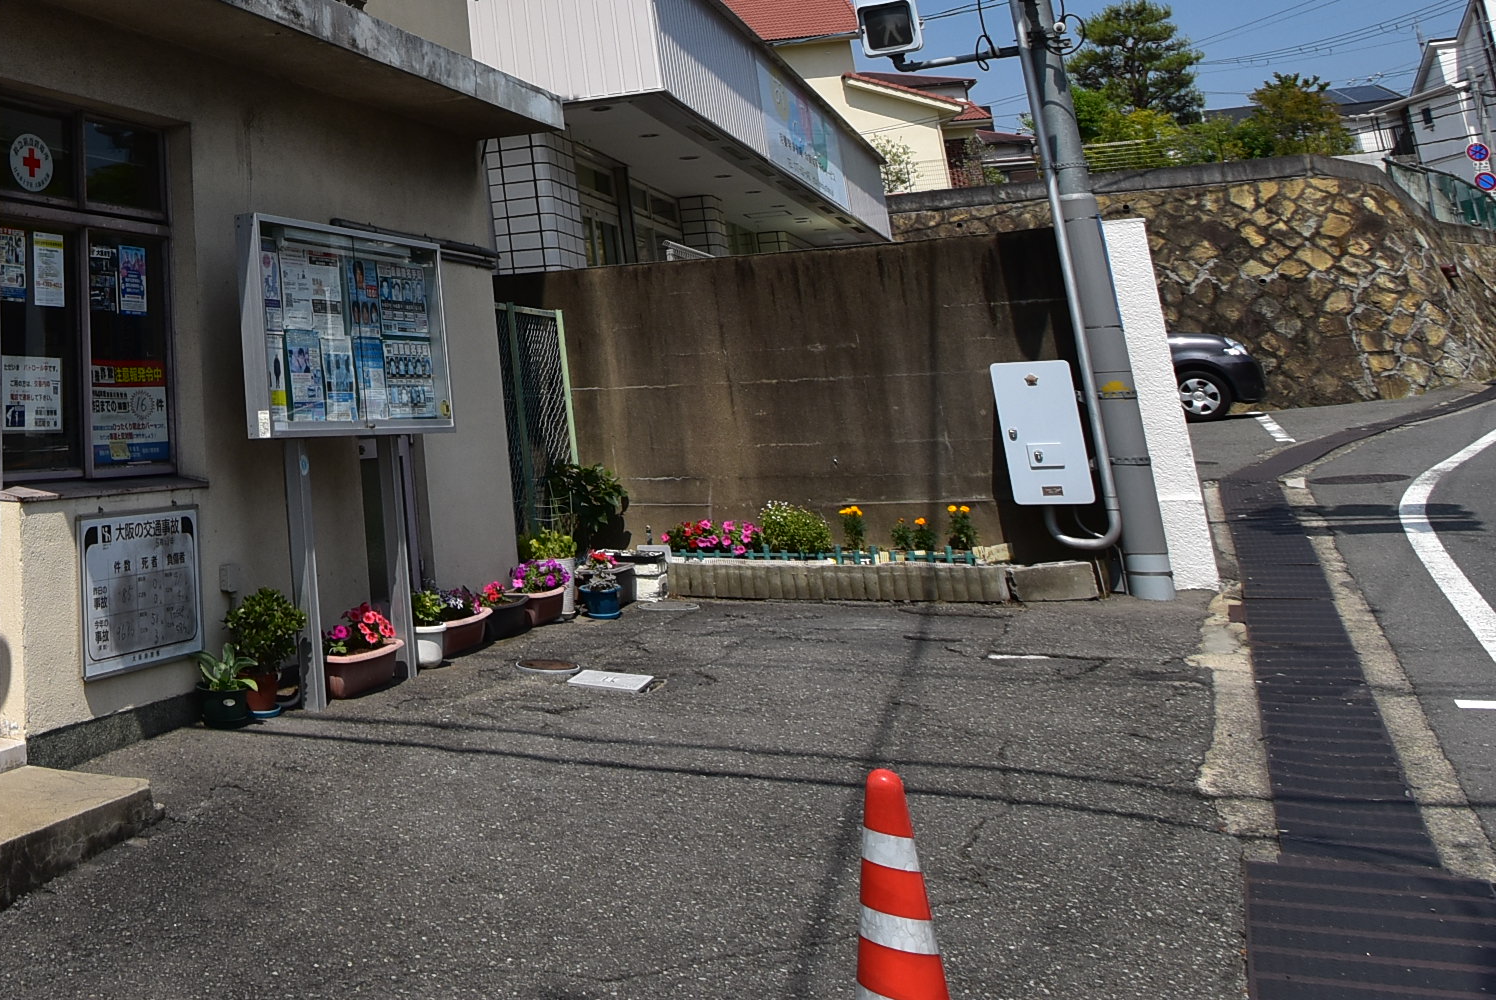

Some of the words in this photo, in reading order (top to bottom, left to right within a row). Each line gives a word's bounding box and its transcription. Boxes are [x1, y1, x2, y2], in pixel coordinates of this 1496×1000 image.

[115, 367, 162, 382] 注意報発令中
[136, 396, 147, 412] 16
[156, 399, 164, 411] 件
[115, 518, 179, 541] 大阪の交通事故
